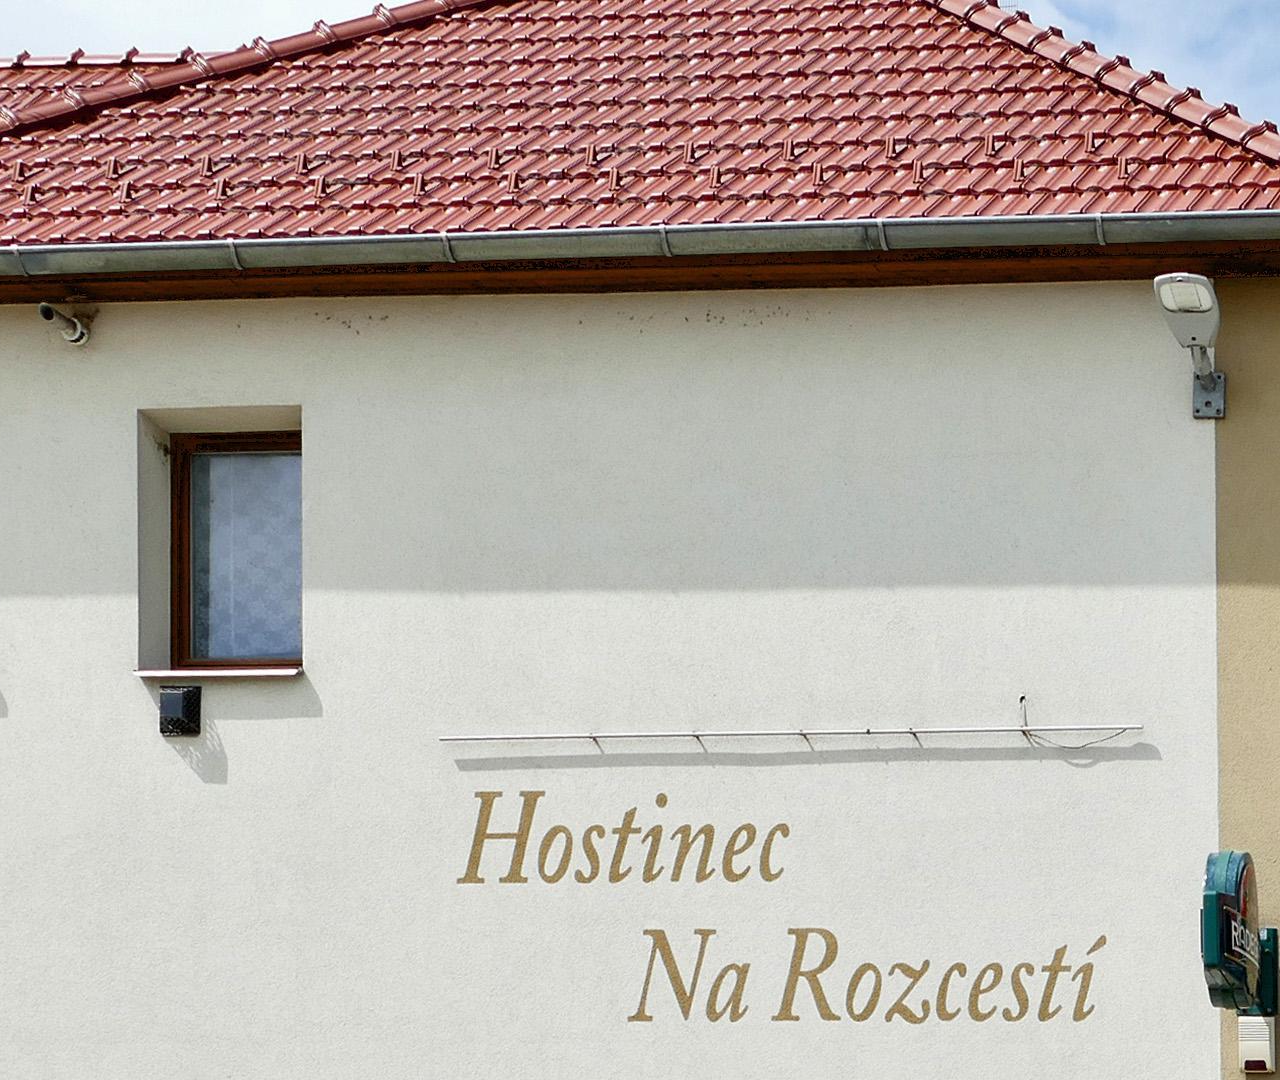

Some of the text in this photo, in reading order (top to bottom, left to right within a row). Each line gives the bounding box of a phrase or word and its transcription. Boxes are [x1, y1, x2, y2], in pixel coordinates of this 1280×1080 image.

[457, 790, 790, 884] Hostinec
[627, 927, 1107, 1024] Na Rozcestí
